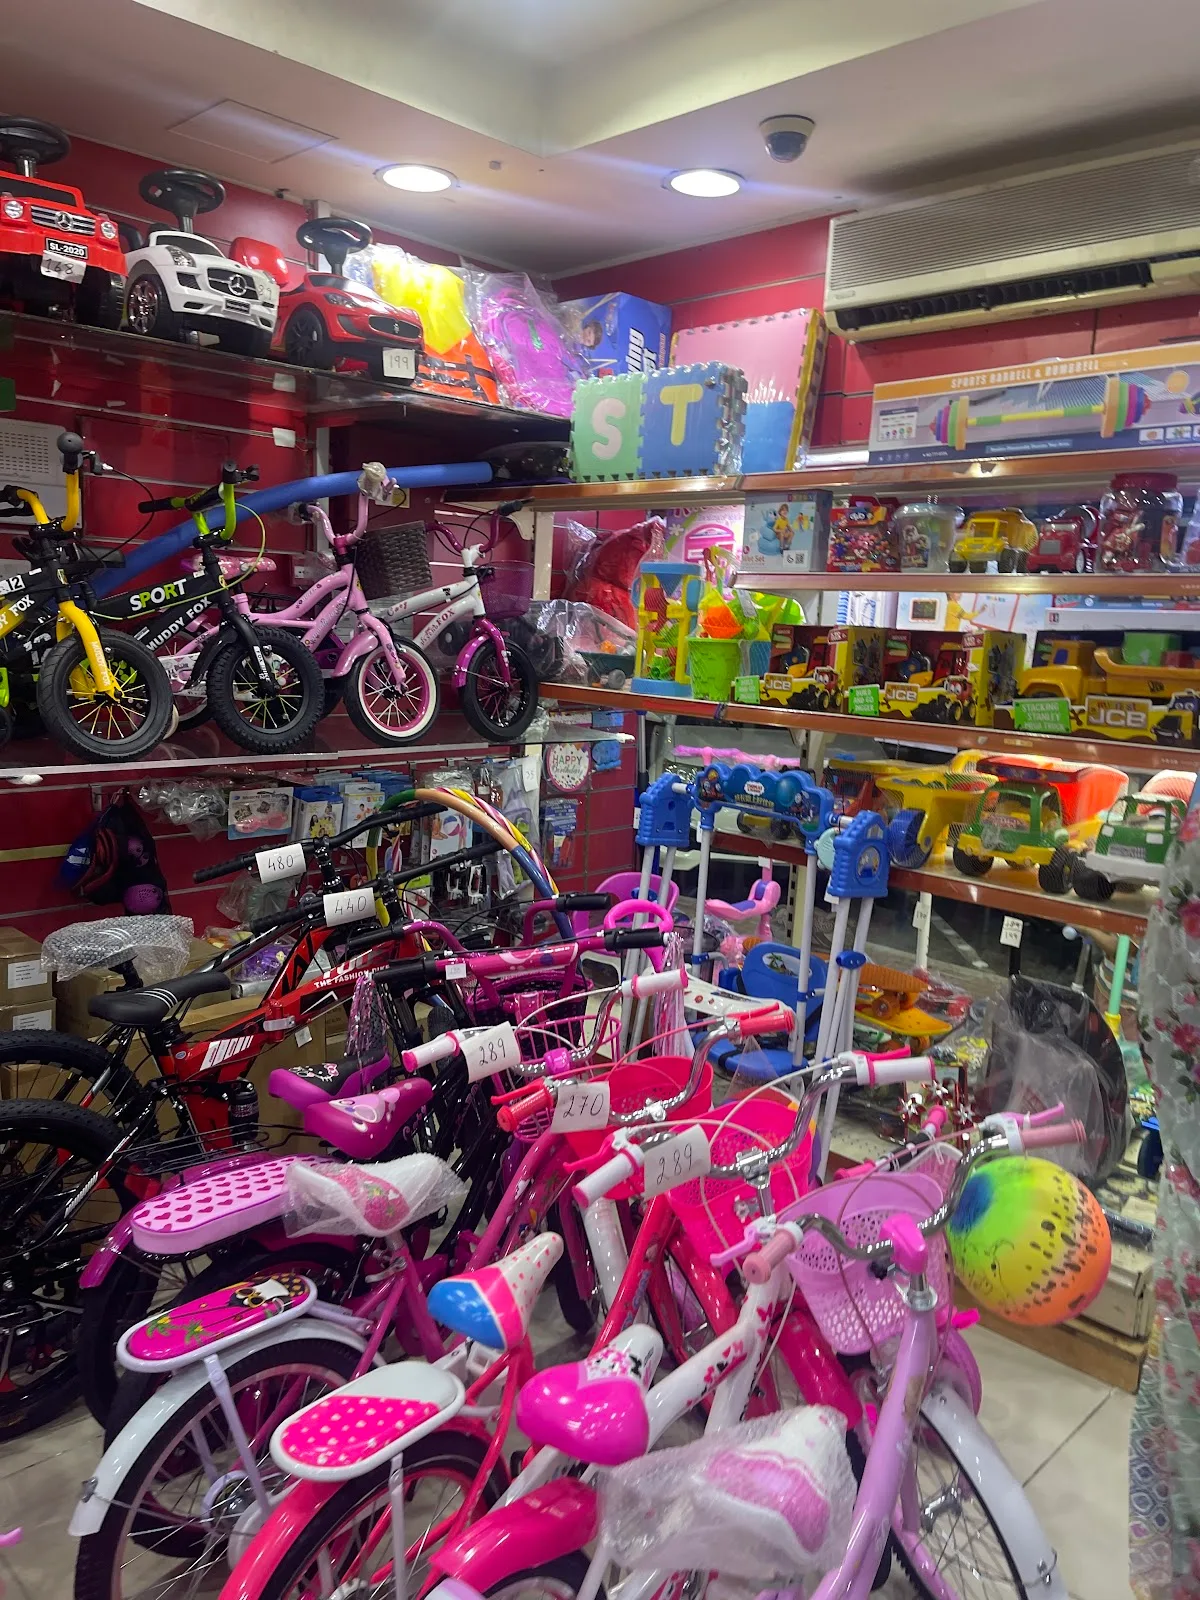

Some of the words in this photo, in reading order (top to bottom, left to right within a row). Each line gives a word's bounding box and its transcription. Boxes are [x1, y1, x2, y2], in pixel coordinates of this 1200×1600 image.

[49, 242, 85, 257] SL-2020
[390, 355, 409, 370] 199
[659, 383, 704, 446] T
[592, 397, 626, 461] S
[129, 578, 187, 612] SPORT
[8, 594, 35, 617] FOX
[146, 616, 186, 651] MUDDY
[185, 596, 212, 619] FOX
[765, 679, 791, 691] JCB
[886, 689, 918, 702] JCB
[1089, 708, 1147, 728] JCB
[553, 755, 583, 765] HAPPY
[552, 765, 584, 776] Birthday
[268, 854, 294, 872] 480
[334, 895, 367, 916] 440
[314, 979, 332, 989] THE
[334, 969, 370, 984] FASHION
[479, 1038, 507, 1065] 289
[562, 1093, 604, 1118] 270
[656, 1143, 694, 1185] 289
